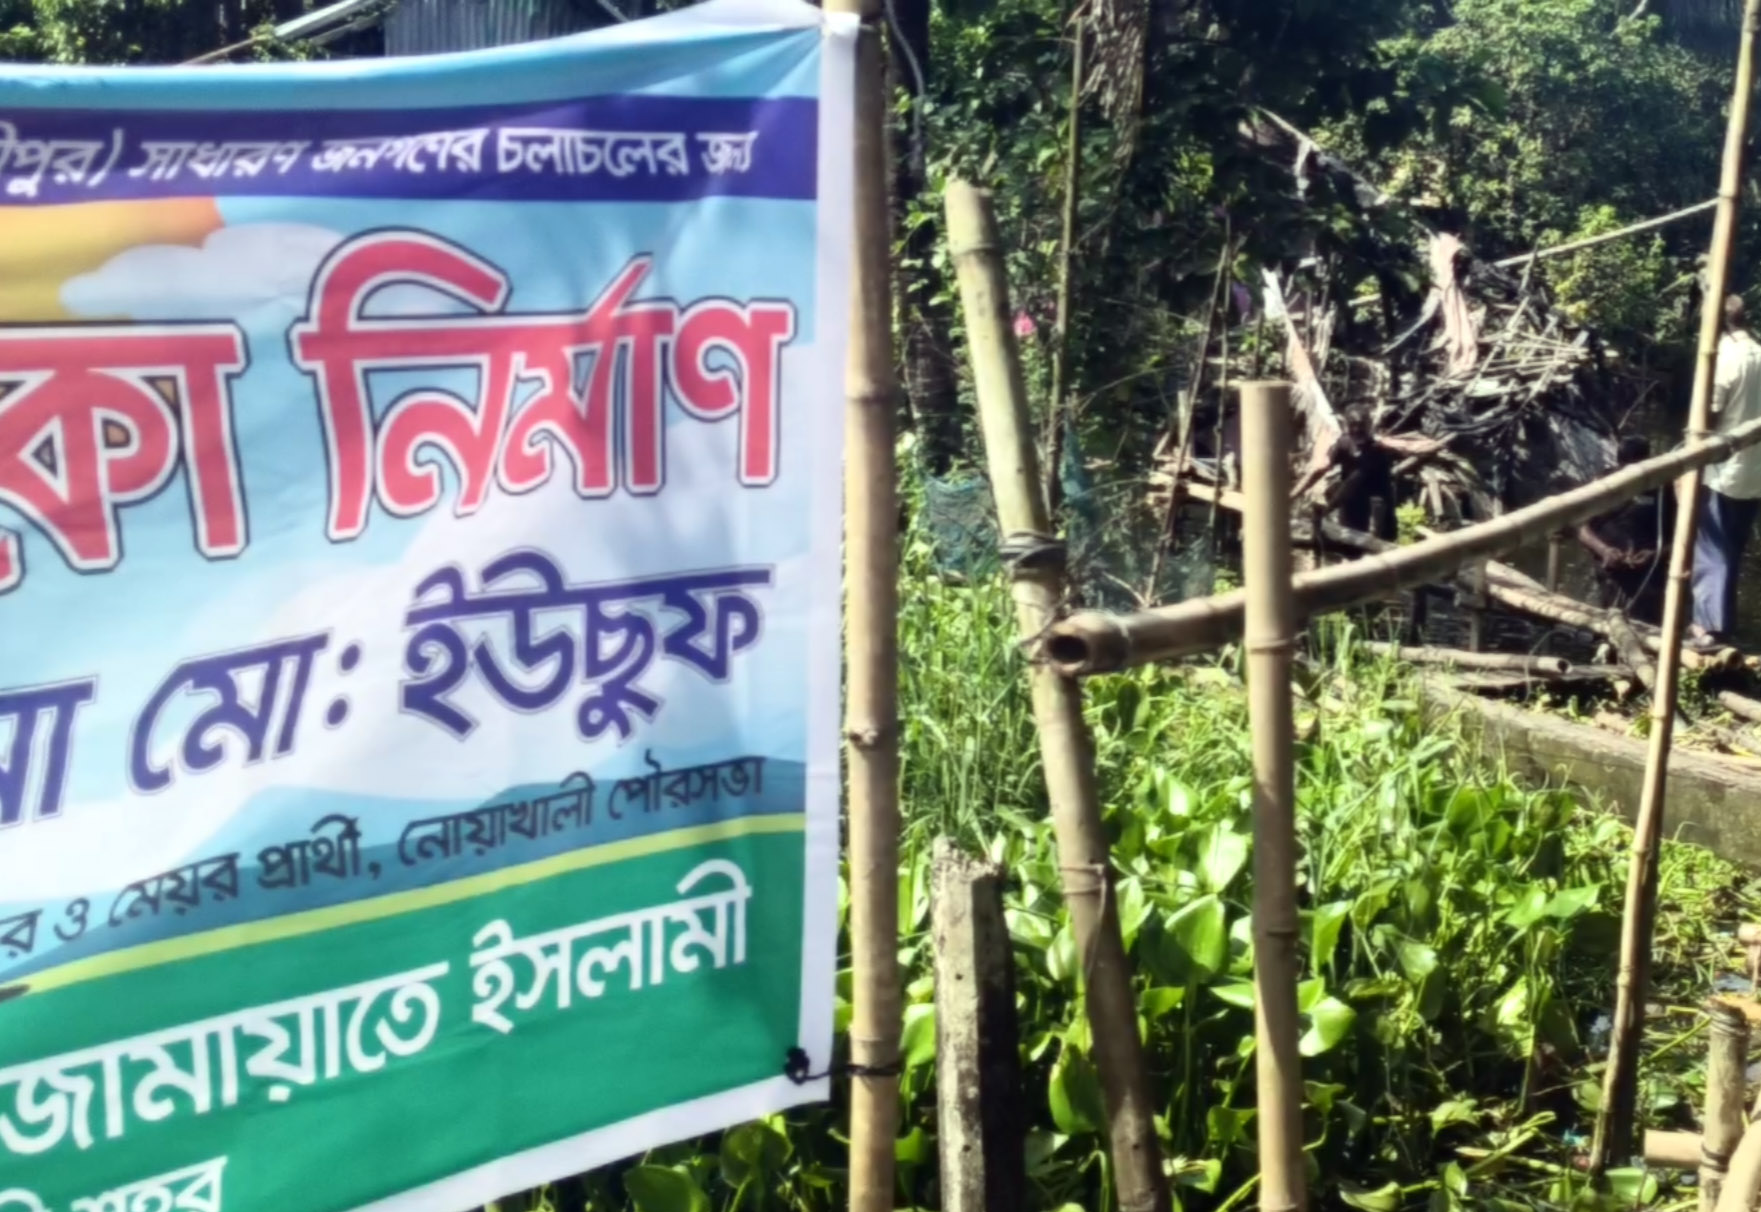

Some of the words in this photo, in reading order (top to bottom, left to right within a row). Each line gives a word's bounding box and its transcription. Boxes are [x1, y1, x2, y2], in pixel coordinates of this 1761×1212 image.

[496, 126, 690, 177] চলাচলের
[0, 319, 251, 596] কো
[287, 226, 797, 543] নির্মাণ
[396, 546, 775, 748] ইউছুফ
[0, 908, 43, 958] র
[53, 896, 91, 942] ও
[107, 851, 241, 929] মেয়র
[396, 769, 597, 867] নোয়াখালী
[607, 747, 768, 821] পৌরসভা
[0, 960, 450, 1156] জামায়াতে
[469, 857, 753, 1035] ইসলামী
